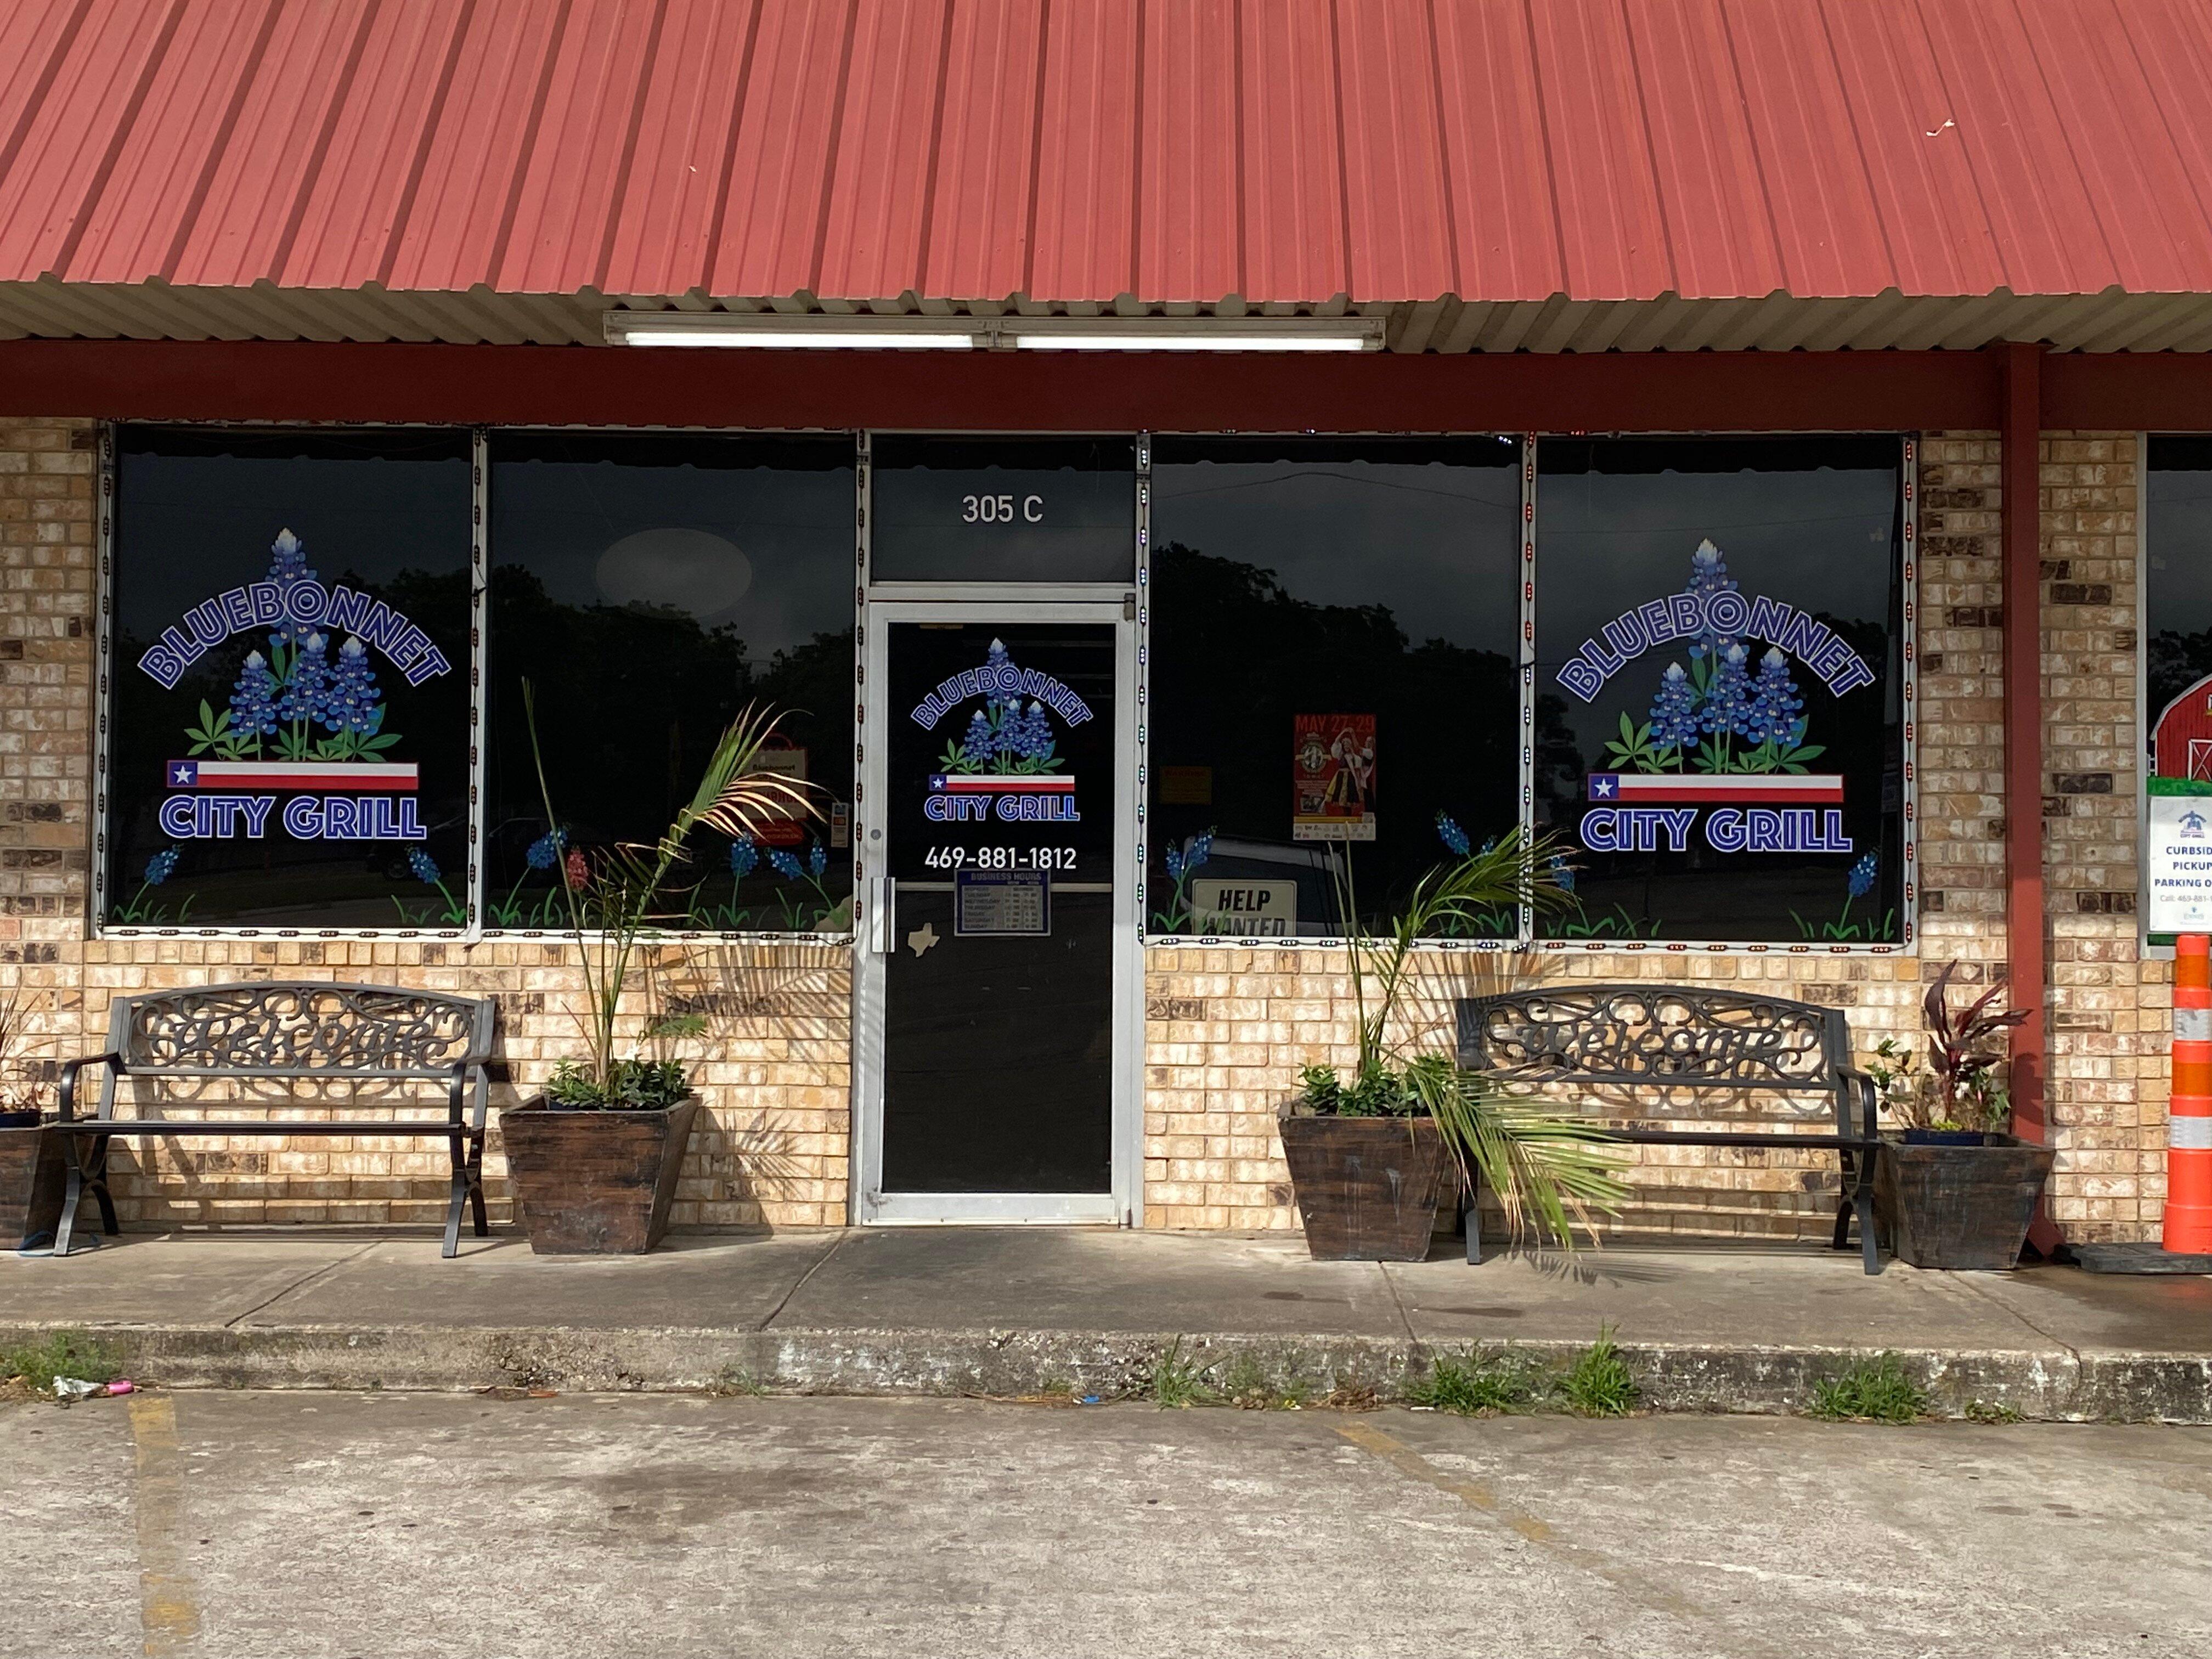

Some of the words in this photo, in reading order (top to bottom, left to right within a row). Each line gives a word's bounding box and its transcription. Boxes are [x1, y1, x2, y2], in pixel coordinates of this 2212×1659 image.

[962, 495, 1014, 523] 305
[1023, 495, 1043, 523] C
[137, 579, 452, 690] BLUEBONNET
[1556, 590, 1876, 703] BLUEBONNET
[910, 664, 1094, 731] BLUEBONNET
[1295, 714, 1327, 732] MAY
[159, 794, 277, 838] CITY
[283, 795, 427, 840] GRILL
[924, 794, 992, 821] CITY
[996, 794, 1080, 821] GRILL
[1580, 808, 1699, 851] CITY
[1706, 808, 1853, 853] GRILL
[924, 847, 1077, 870] 469-881-1812
[2173, 861, 2212, 870] PICKUP
[971, 872, 1012, 881] BUSINESS
[1014, 872, 1042, 881] HOURS
[2154, 878, 2202, 887] PARKING
[1218, 890, 1271, 911] HELP
